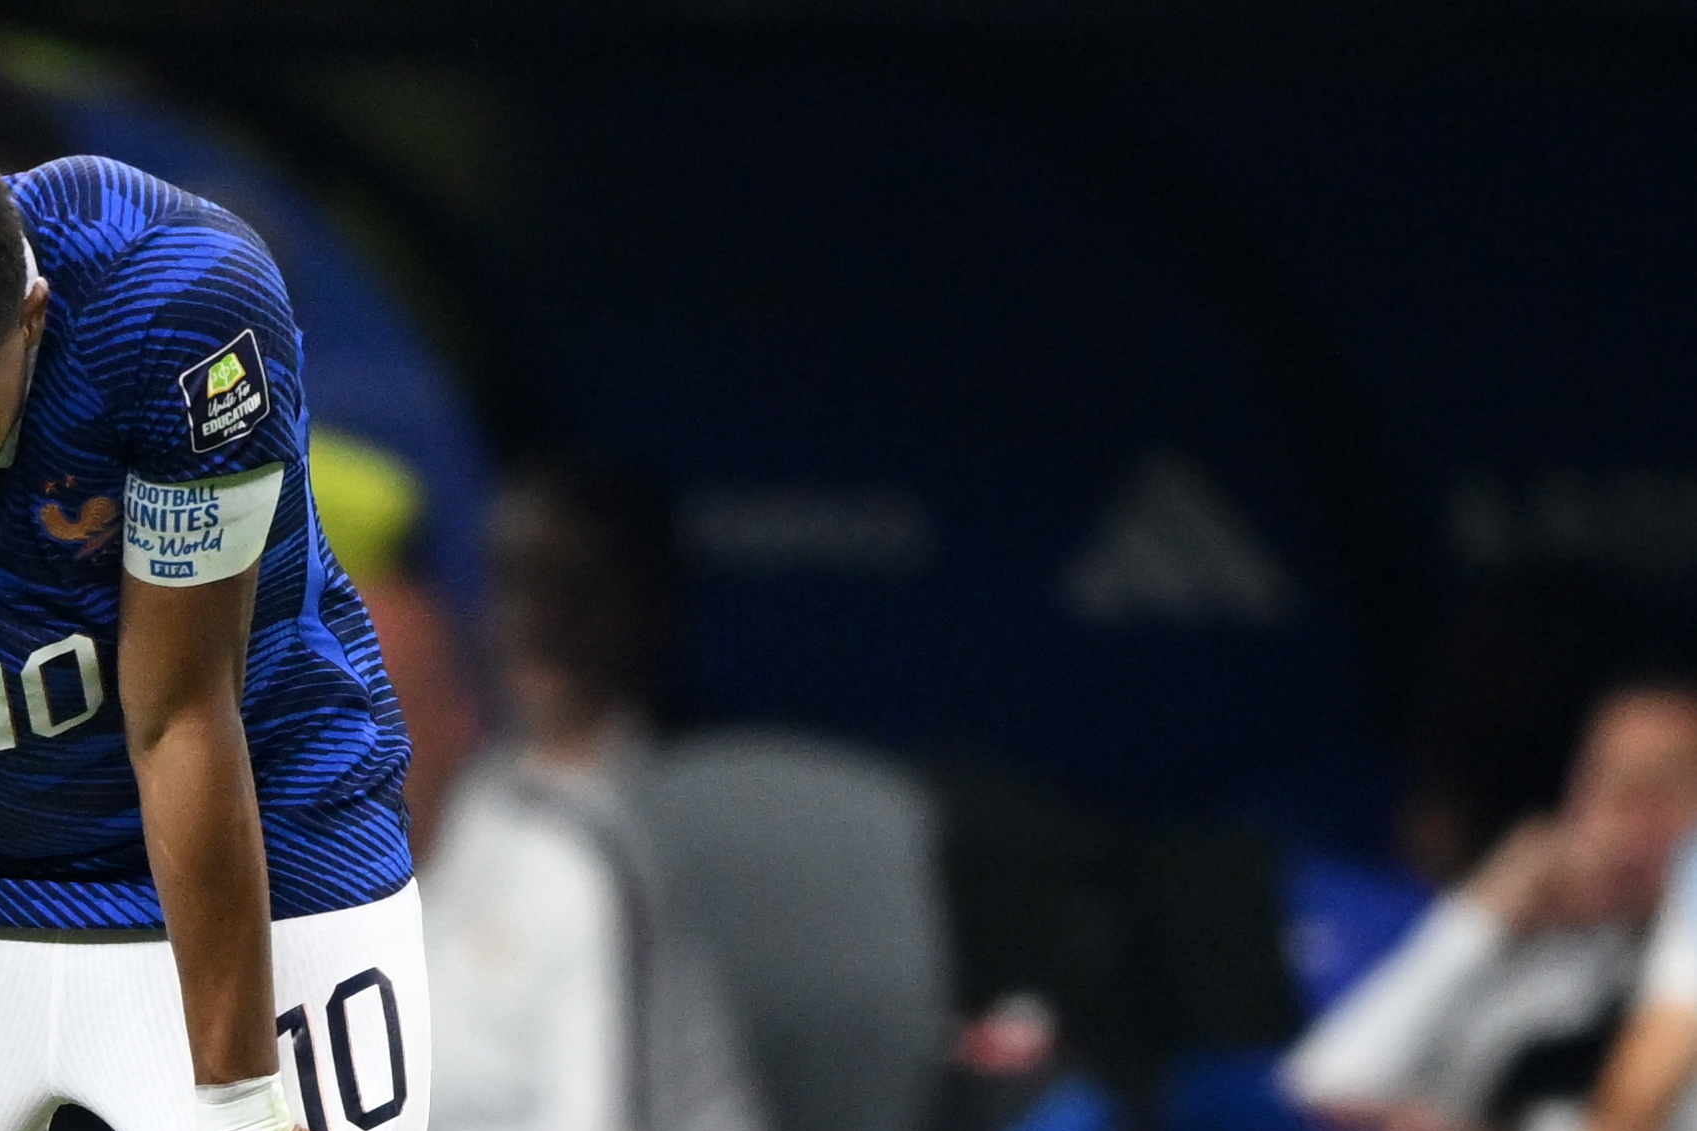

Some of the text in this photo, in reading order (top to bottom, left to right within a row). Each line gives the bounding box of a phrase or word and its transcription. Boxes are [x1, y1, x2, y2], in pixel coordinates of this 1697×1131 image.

[202, 392, 261, 437] EDUCATION
[223, 420, 247, 437] FIFA
[129, 478, 219, 507] FOOTBALL
[127, 497, 219, 533] UNITES
[126, 524, 224, 557] the World
[154, 562, 191, 576] FIFA
